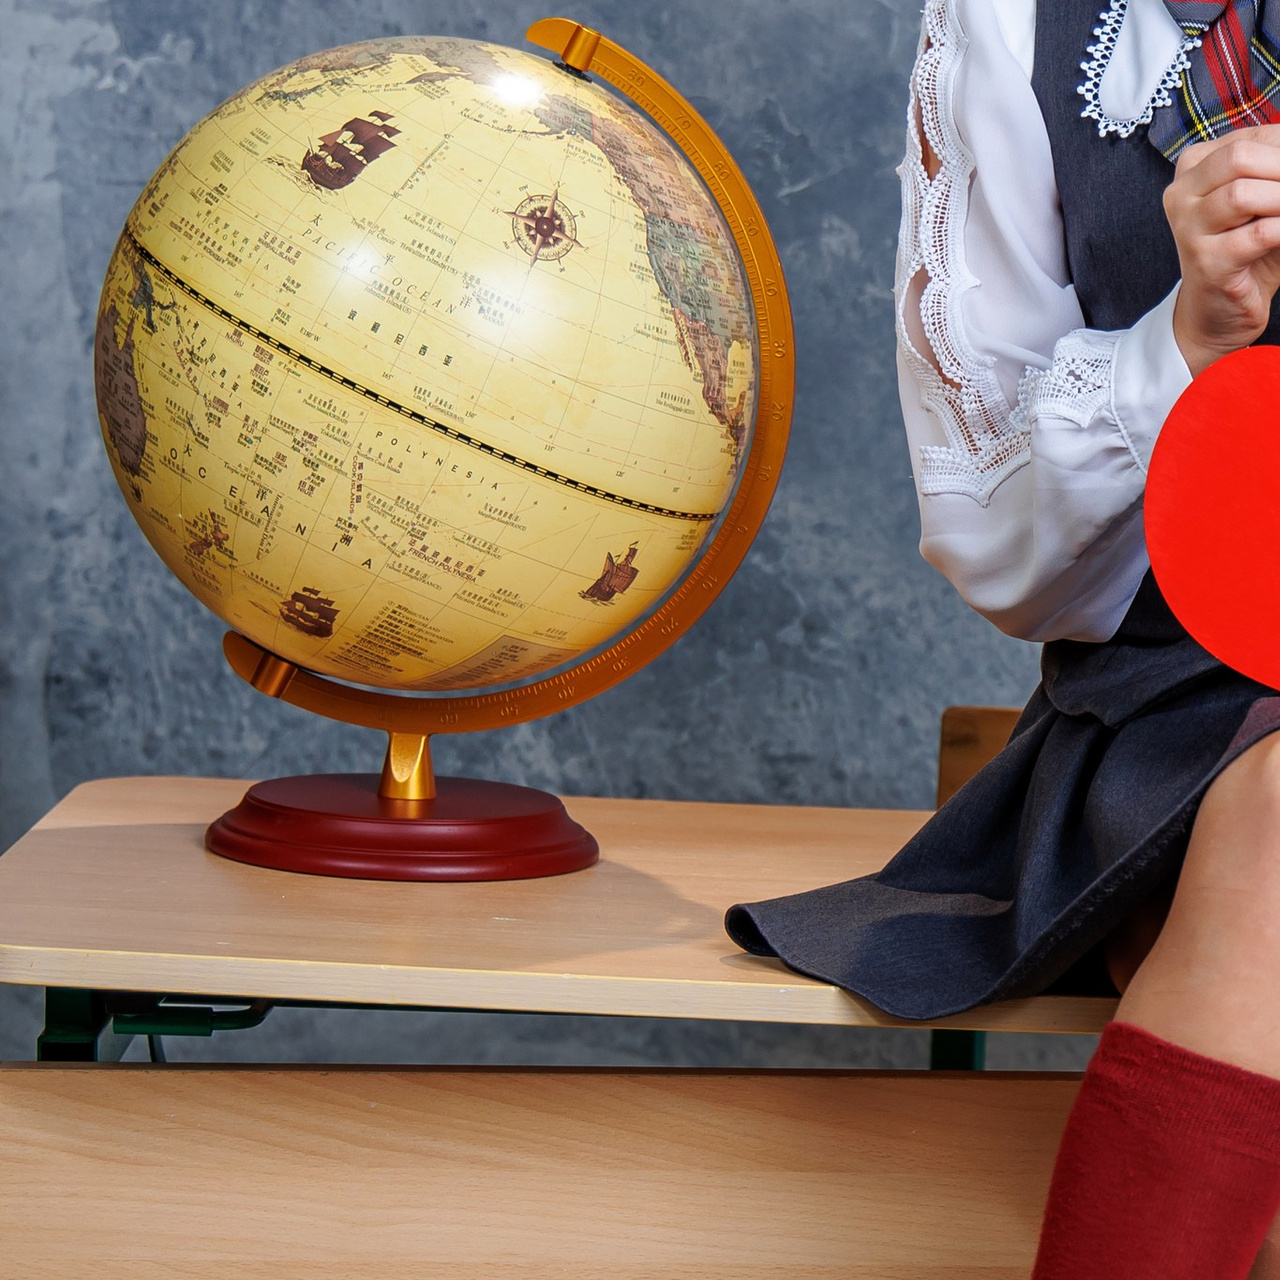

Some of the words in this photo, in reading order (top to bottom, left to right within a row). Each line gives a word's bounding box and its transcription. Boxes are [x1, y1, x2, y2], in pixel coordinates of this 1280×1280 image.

[392, 277, 457, 314] OCEAN
[774, 340, 786, 359] 30
[772, 401, 785, 421] 20
[375, 431, 498, 490] POLYNESIA
[408, 547, 438, 567] FRENCH
[438, 560, 477, 583] POLYNESIA
